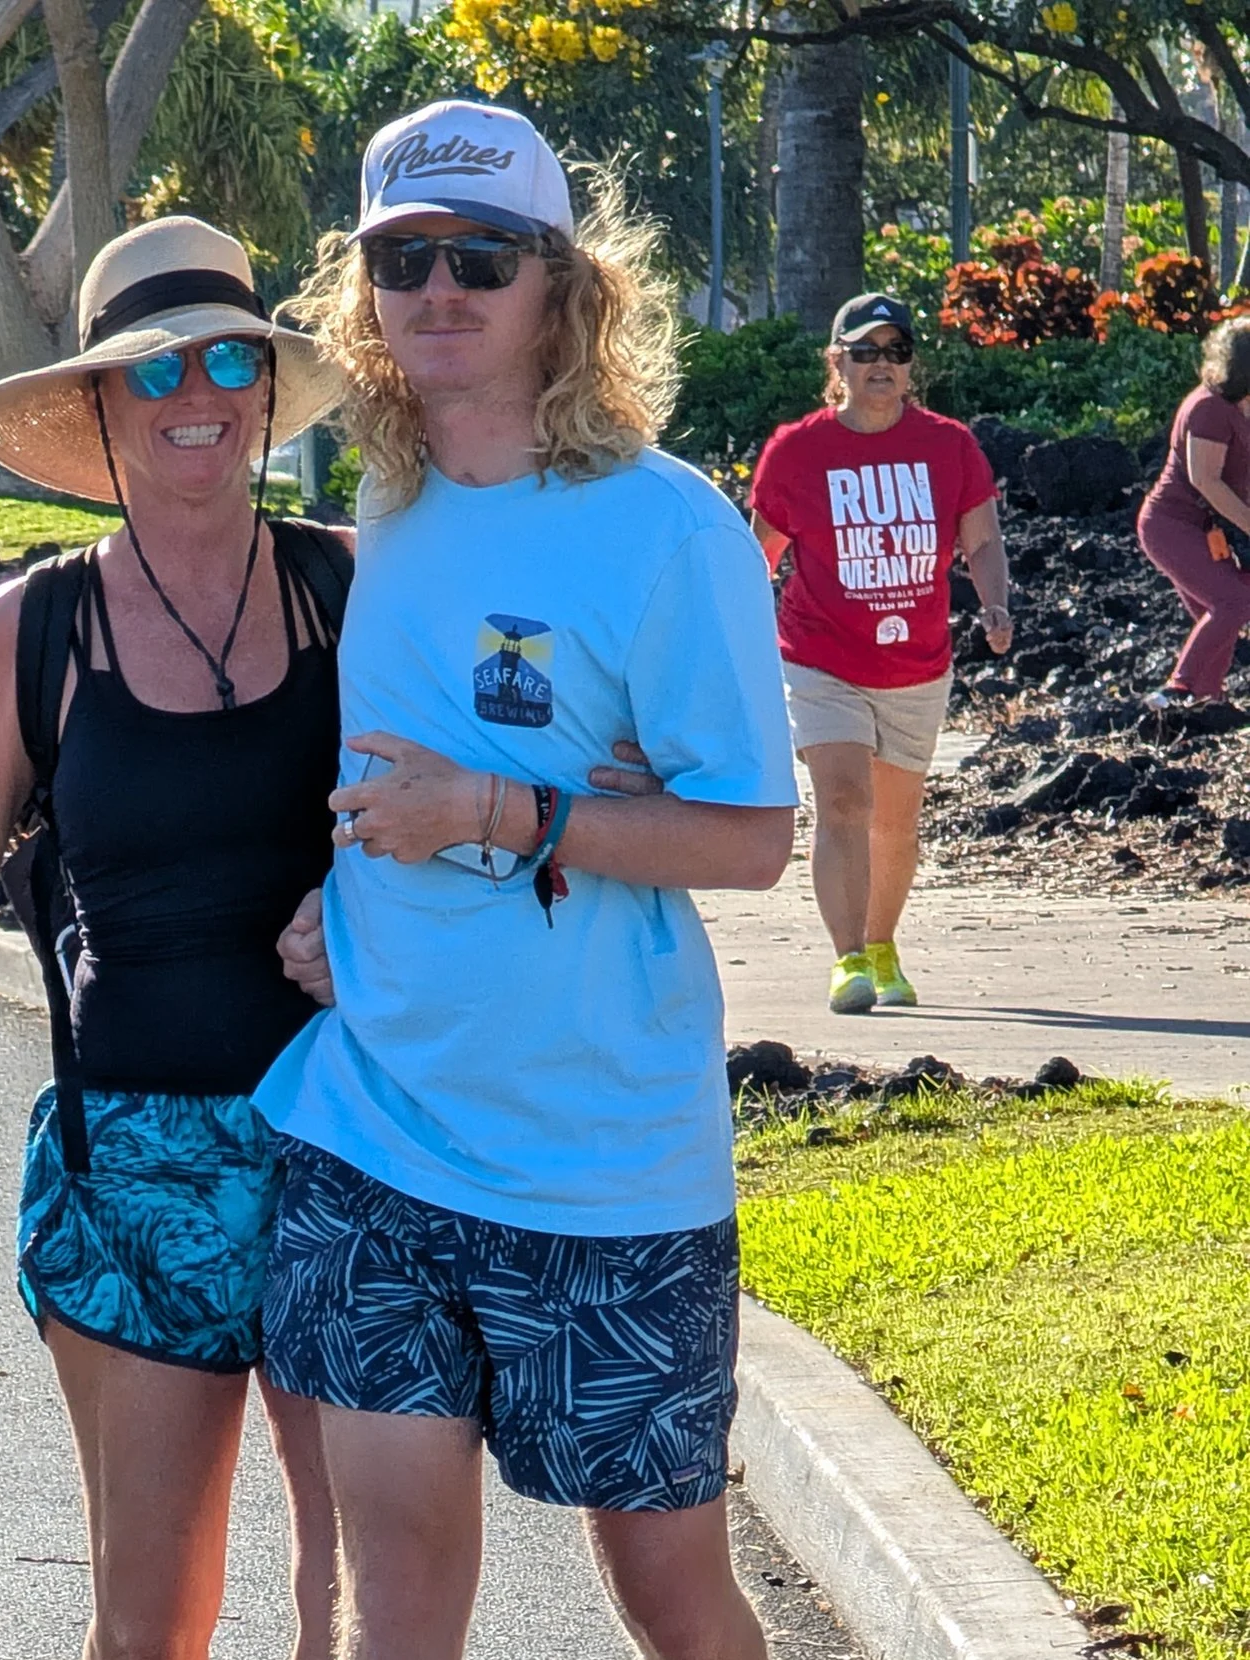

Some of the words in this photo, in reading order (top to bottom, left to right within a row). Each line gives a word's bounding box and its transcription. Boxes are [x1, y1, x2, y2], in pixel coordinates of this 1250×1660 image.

[382, 131, 515, 191] Padres
[826, 462, 936, 526] RUN
[835, 526, 886, 560] LIKE
[888, 523, 938, 555] YOU
[837, 556, 909, 590] MEAN
[910, 555, 938, 584] IT!
